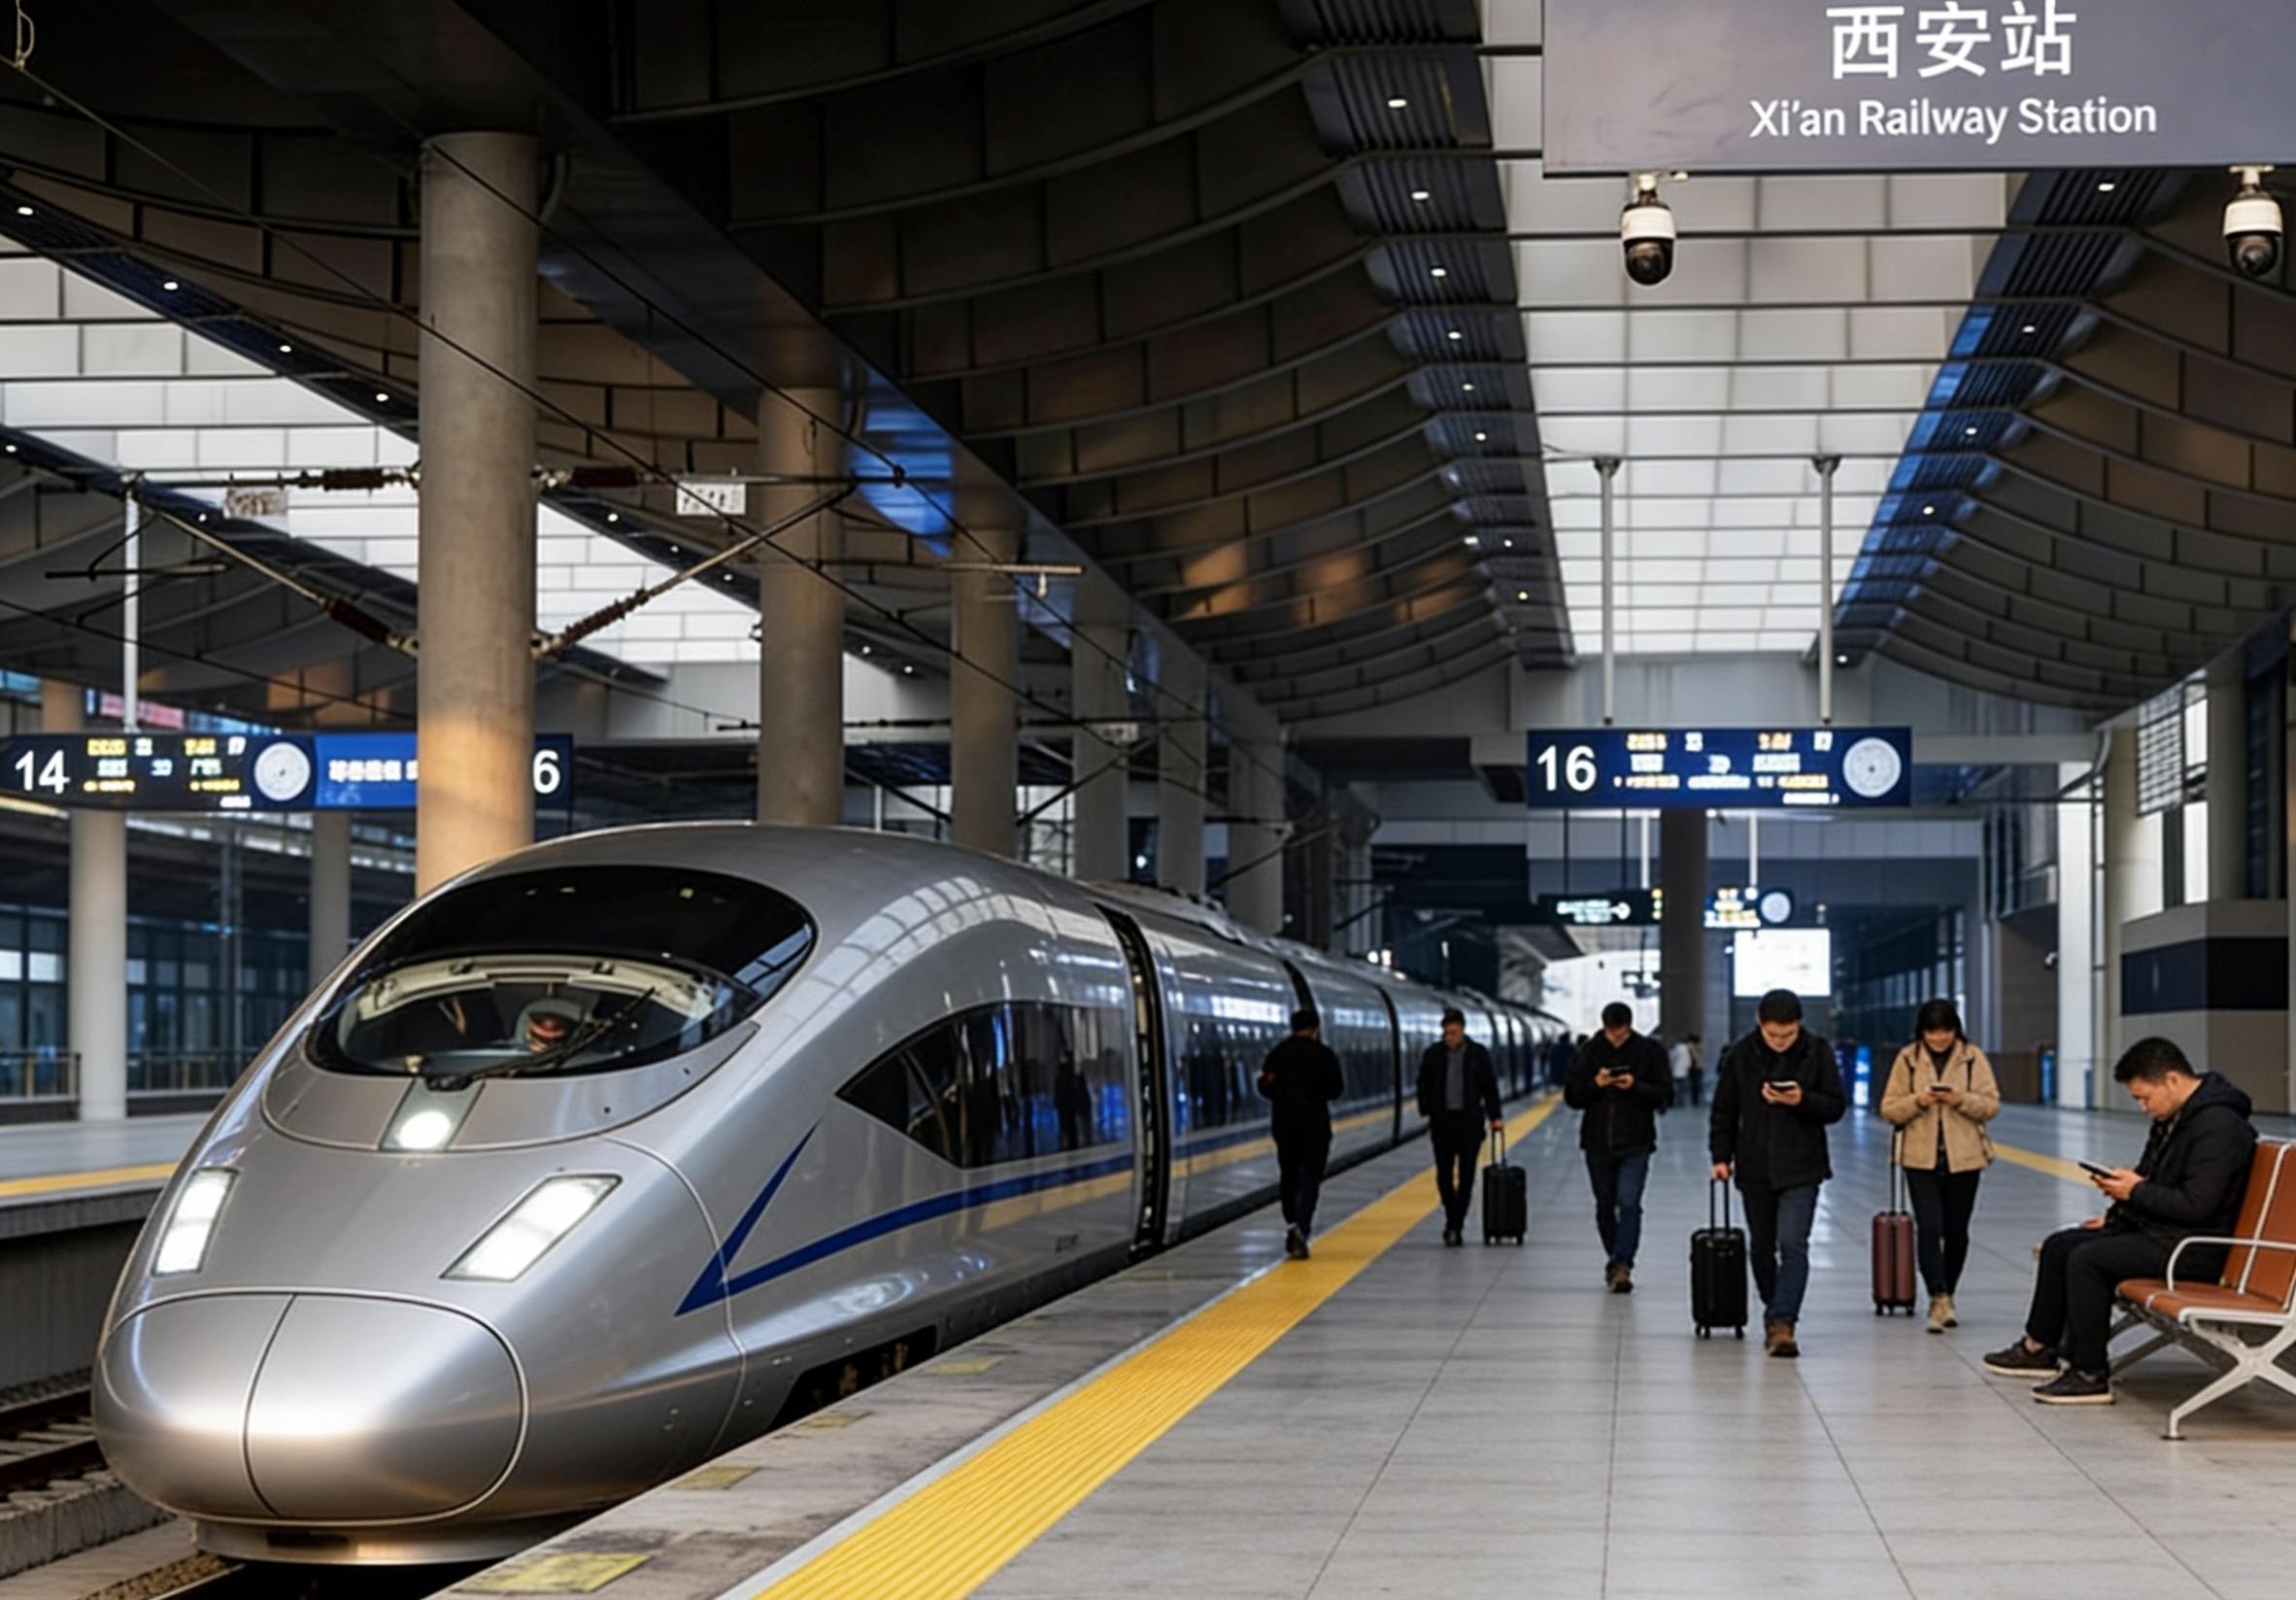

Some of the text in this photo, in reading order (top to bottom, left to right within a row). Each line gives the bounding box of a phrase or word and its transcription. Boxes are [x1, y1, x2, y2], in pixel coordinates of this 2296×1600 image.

[1826, 0, 2077, 80] 西安站
[1749, 96, 2156, 145] Xi'an Railway Station
[15, 749, 71, 794] 14
[1536, 745, 1597, 792] 16
